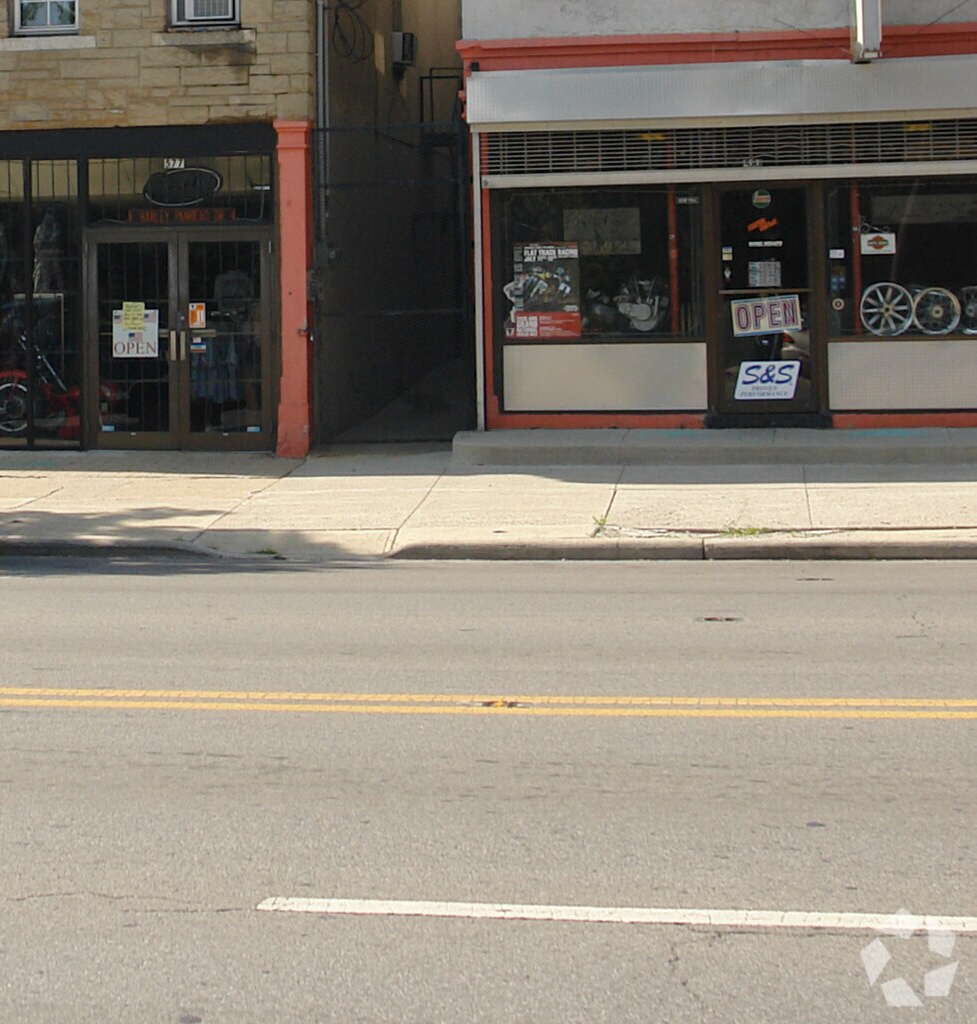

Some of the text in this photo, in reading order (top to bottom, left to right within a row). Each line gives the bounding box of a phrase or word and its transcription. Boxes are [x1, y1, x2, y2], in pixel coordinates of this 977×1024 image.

[164, 158, 185, 169] 577
[735, 299, 799, 332] OPEN
[114, 341, 157, 355] OPEN
[741, 364, 794, 385] S&S
